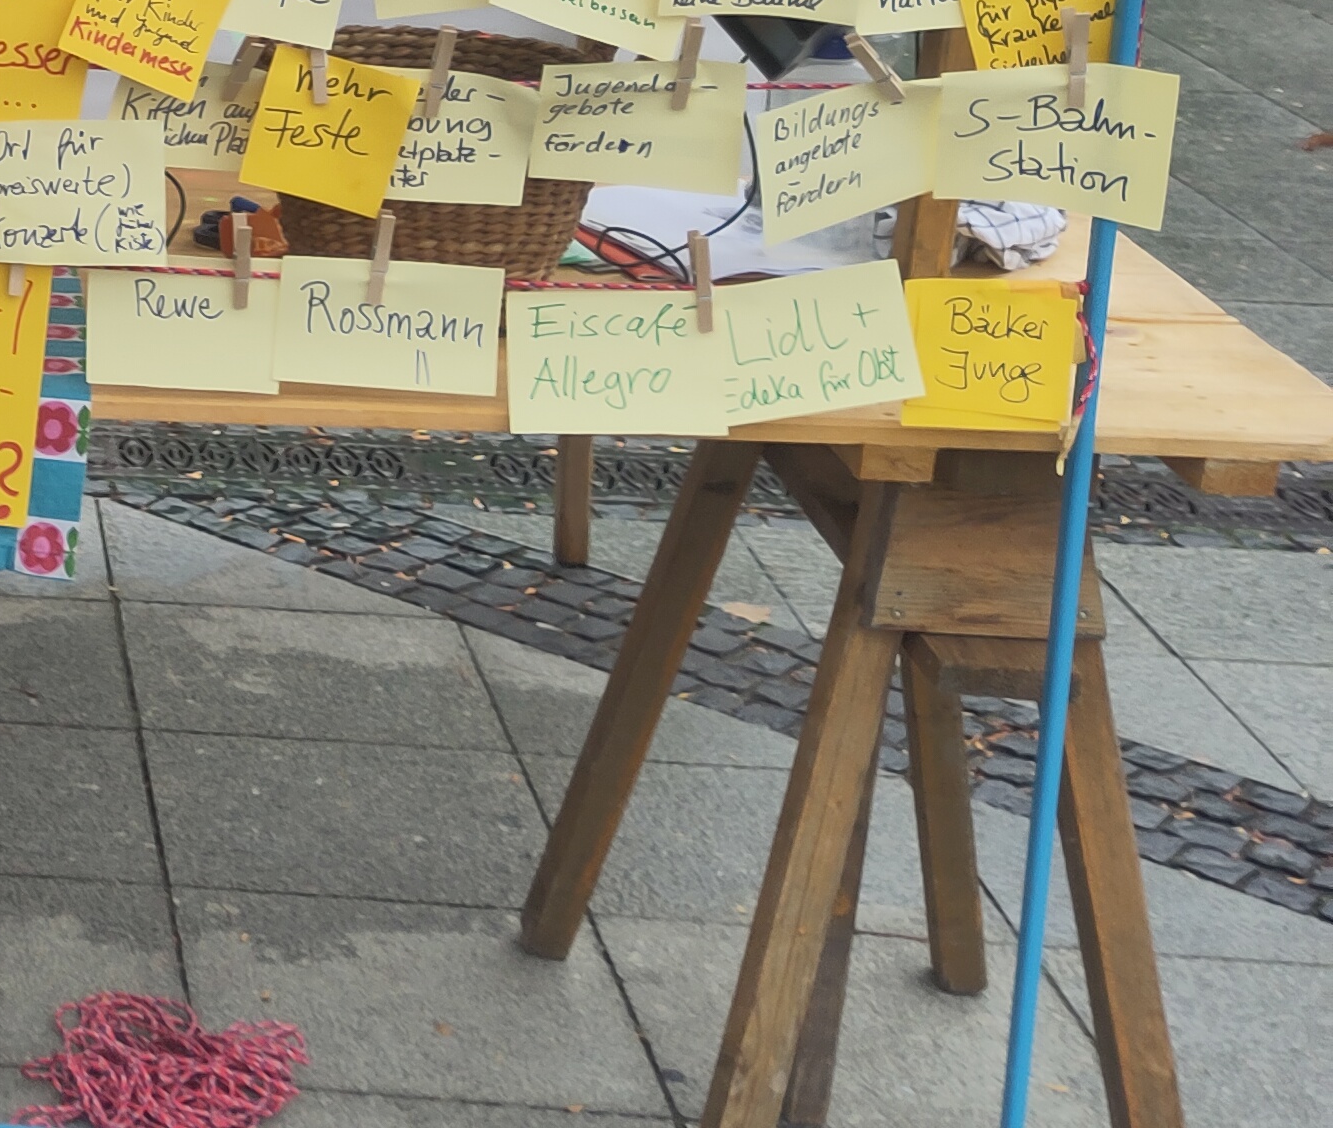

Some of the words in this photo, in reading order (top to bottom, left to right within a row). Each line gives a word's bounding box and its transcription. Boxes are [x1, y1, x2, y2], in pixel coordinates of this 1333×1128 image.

[264, 106, 370, 156] Feste
[542, 97, 635, 124] gebote
[773, 98, 903, 143] Bildungs-
[774, 129, 862, 175] angebote
[988, 139, 1131, 203] Station
[776, 169, 863, 218] fördern
[134, 277, 224, 321] Rewe
[299, 279, 484, 349] Rossmann
[531, 302, 699, 341] Eiscafé
[942, 295, 1049, 341] Bäcker
[725, 298, 849, 366] Lidl
[531, 359, 673, 410] Allegro
[934, 348, 1047, 404] Junge
